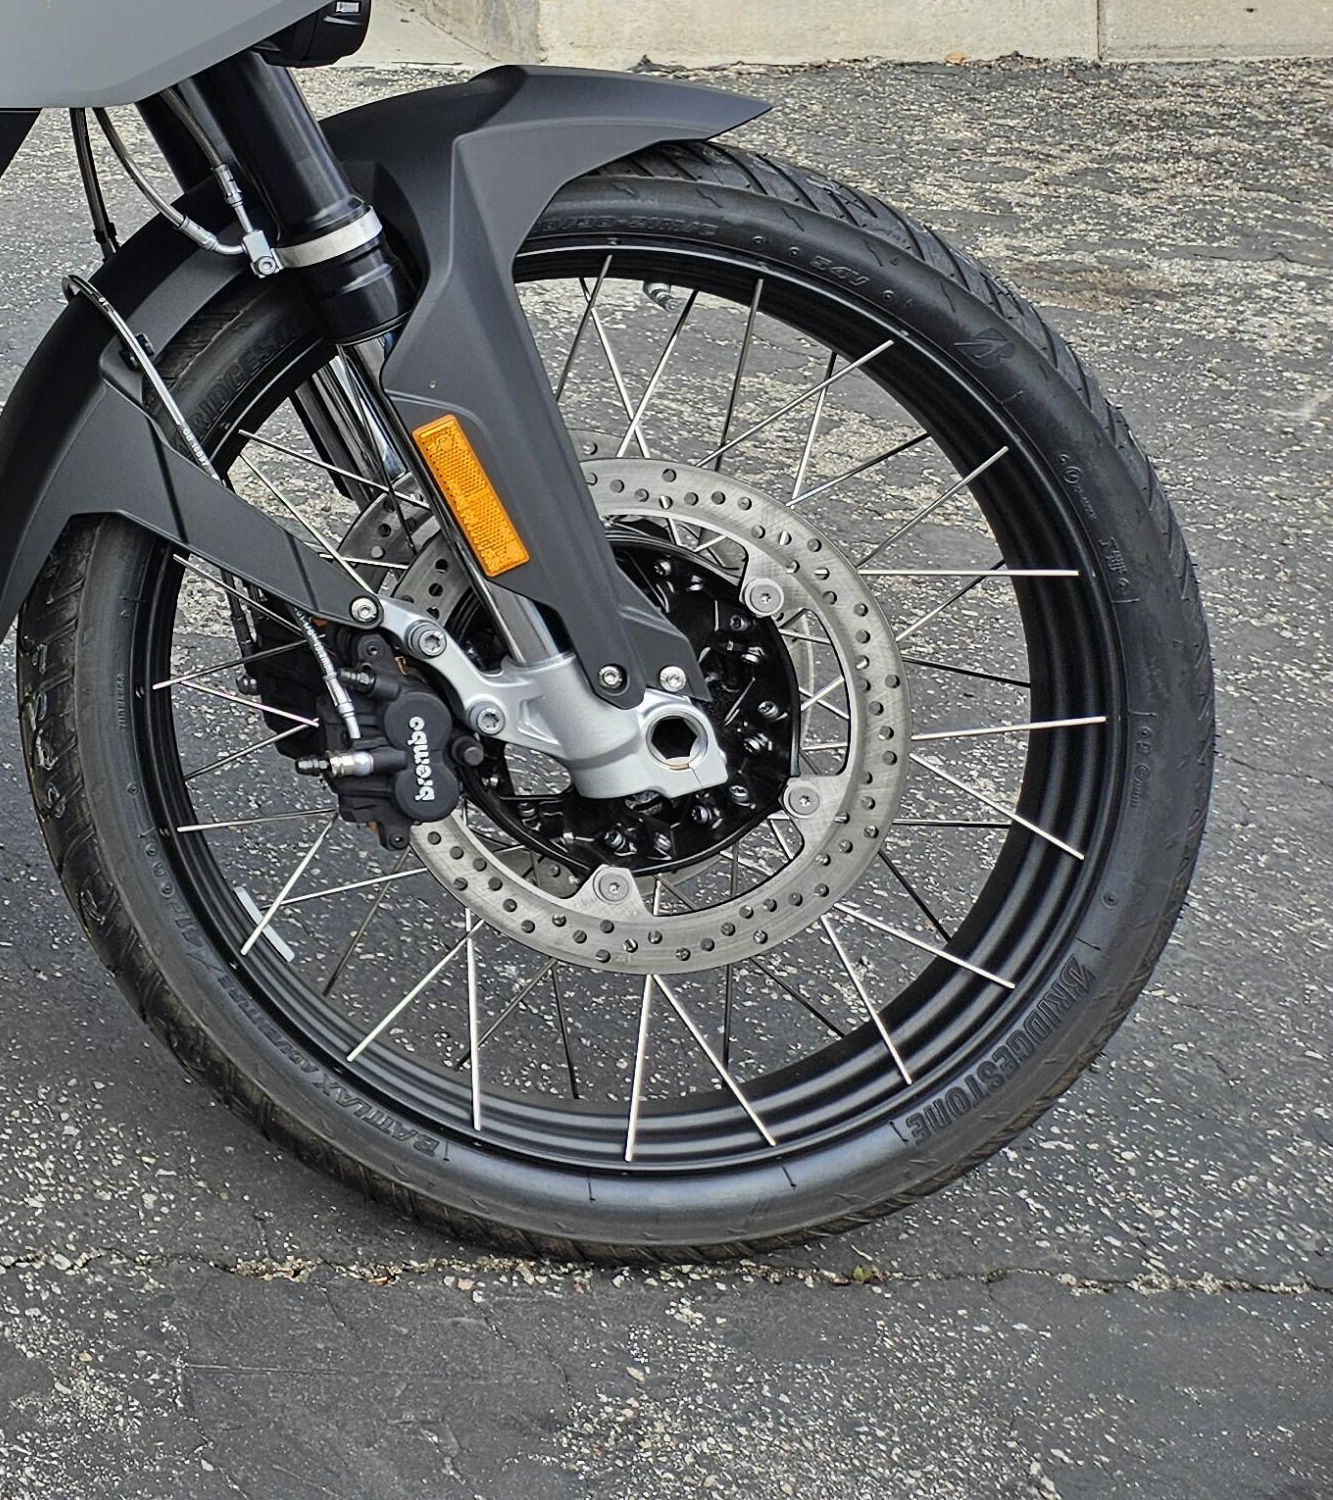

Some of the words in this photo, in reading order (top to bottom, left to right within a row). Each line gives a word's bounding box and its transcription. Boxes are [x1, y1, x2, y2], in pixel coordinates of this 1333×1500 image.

[406, 716, 435, 801] brembo
[902, 954, 1101, 1146] BRIDGESTONE
[311, 1076, 439, 1159] BATTLAX
